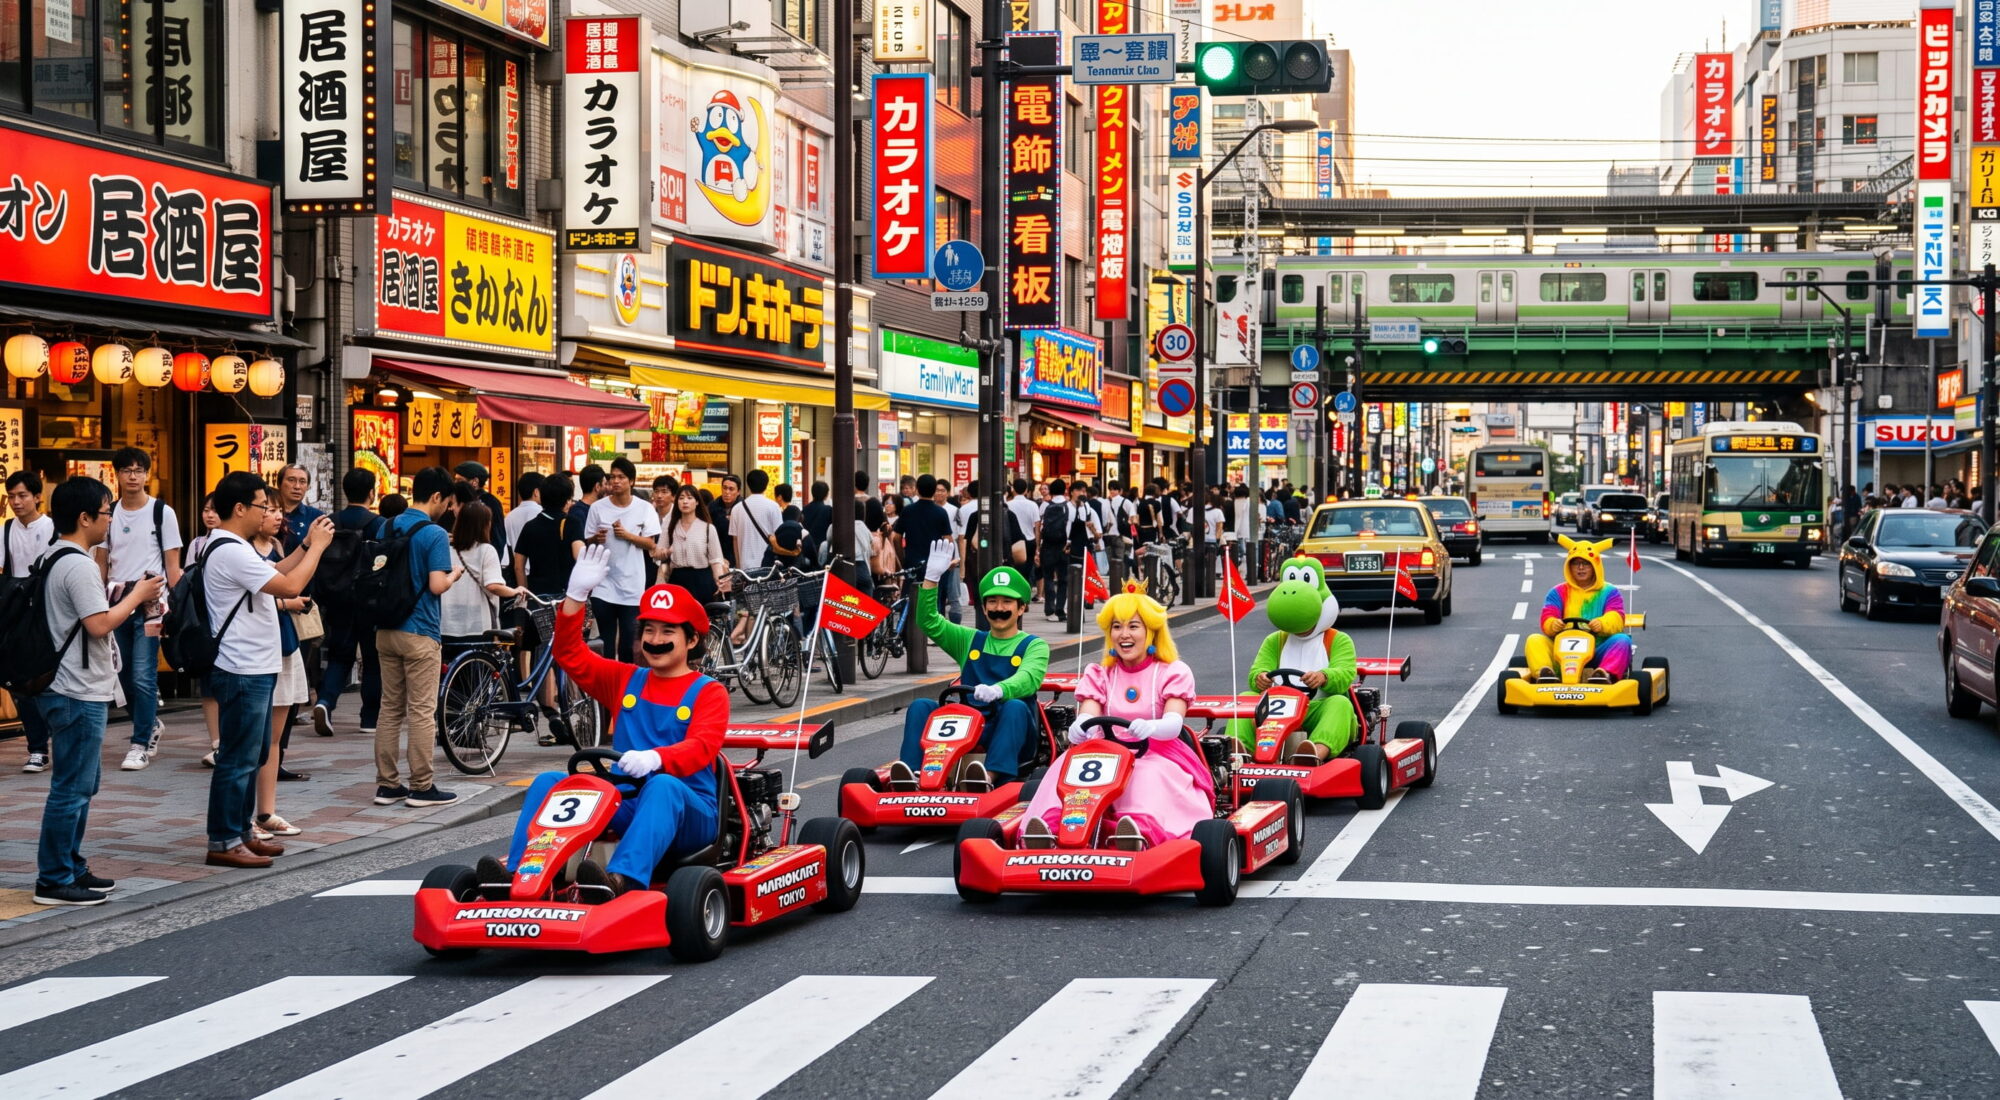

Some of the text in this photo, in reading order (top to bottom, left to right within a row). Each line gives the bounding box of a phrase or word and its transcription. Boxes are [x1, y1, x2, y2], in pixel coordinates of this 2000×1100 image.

[299, 10, 348, 182] 居酒屋
[1704, 58, 1725, 149] カラオケ
[584, 79, 618, 225] カラオケ
[882, 96, 919, 257] カラオケ
[1013, 85, 1051, 304] 電飾看板
[88, 174, 263, 297] 居酒屋
[387, 213, 436, 247] カラオケ
[381, 248, 440, 314] 居酒屋
[450, 260, 548, 336] きかなん
[1166, 335, 1187, 350] 30
[1876, 425, 1955, 442] SUZU
[998, 574, 1005, 584] L
[653, 594, 670, 606] M
[1568, 640, 1580, 650] 7
[1269, 699, 1286, 715] 2
[938, 720, 958, 738] 5
[1079, 760, 1102, 782] 8
[552, 798, 581, 823] 3
[879, 796, 979, 806] MARIOKART
[904, 806, 947, 817] TOKYO
[1006, 855, 1132, 867] MARIOKART
[757, 861, 820, 898] MARIOKART
[1039, 868, 1093, 881] TOKYO
[778, 886, 806, 910] TOKYO
[455, 907, 586, 921] MARIOKART
[486, 923, 541, 937] TOKYO
